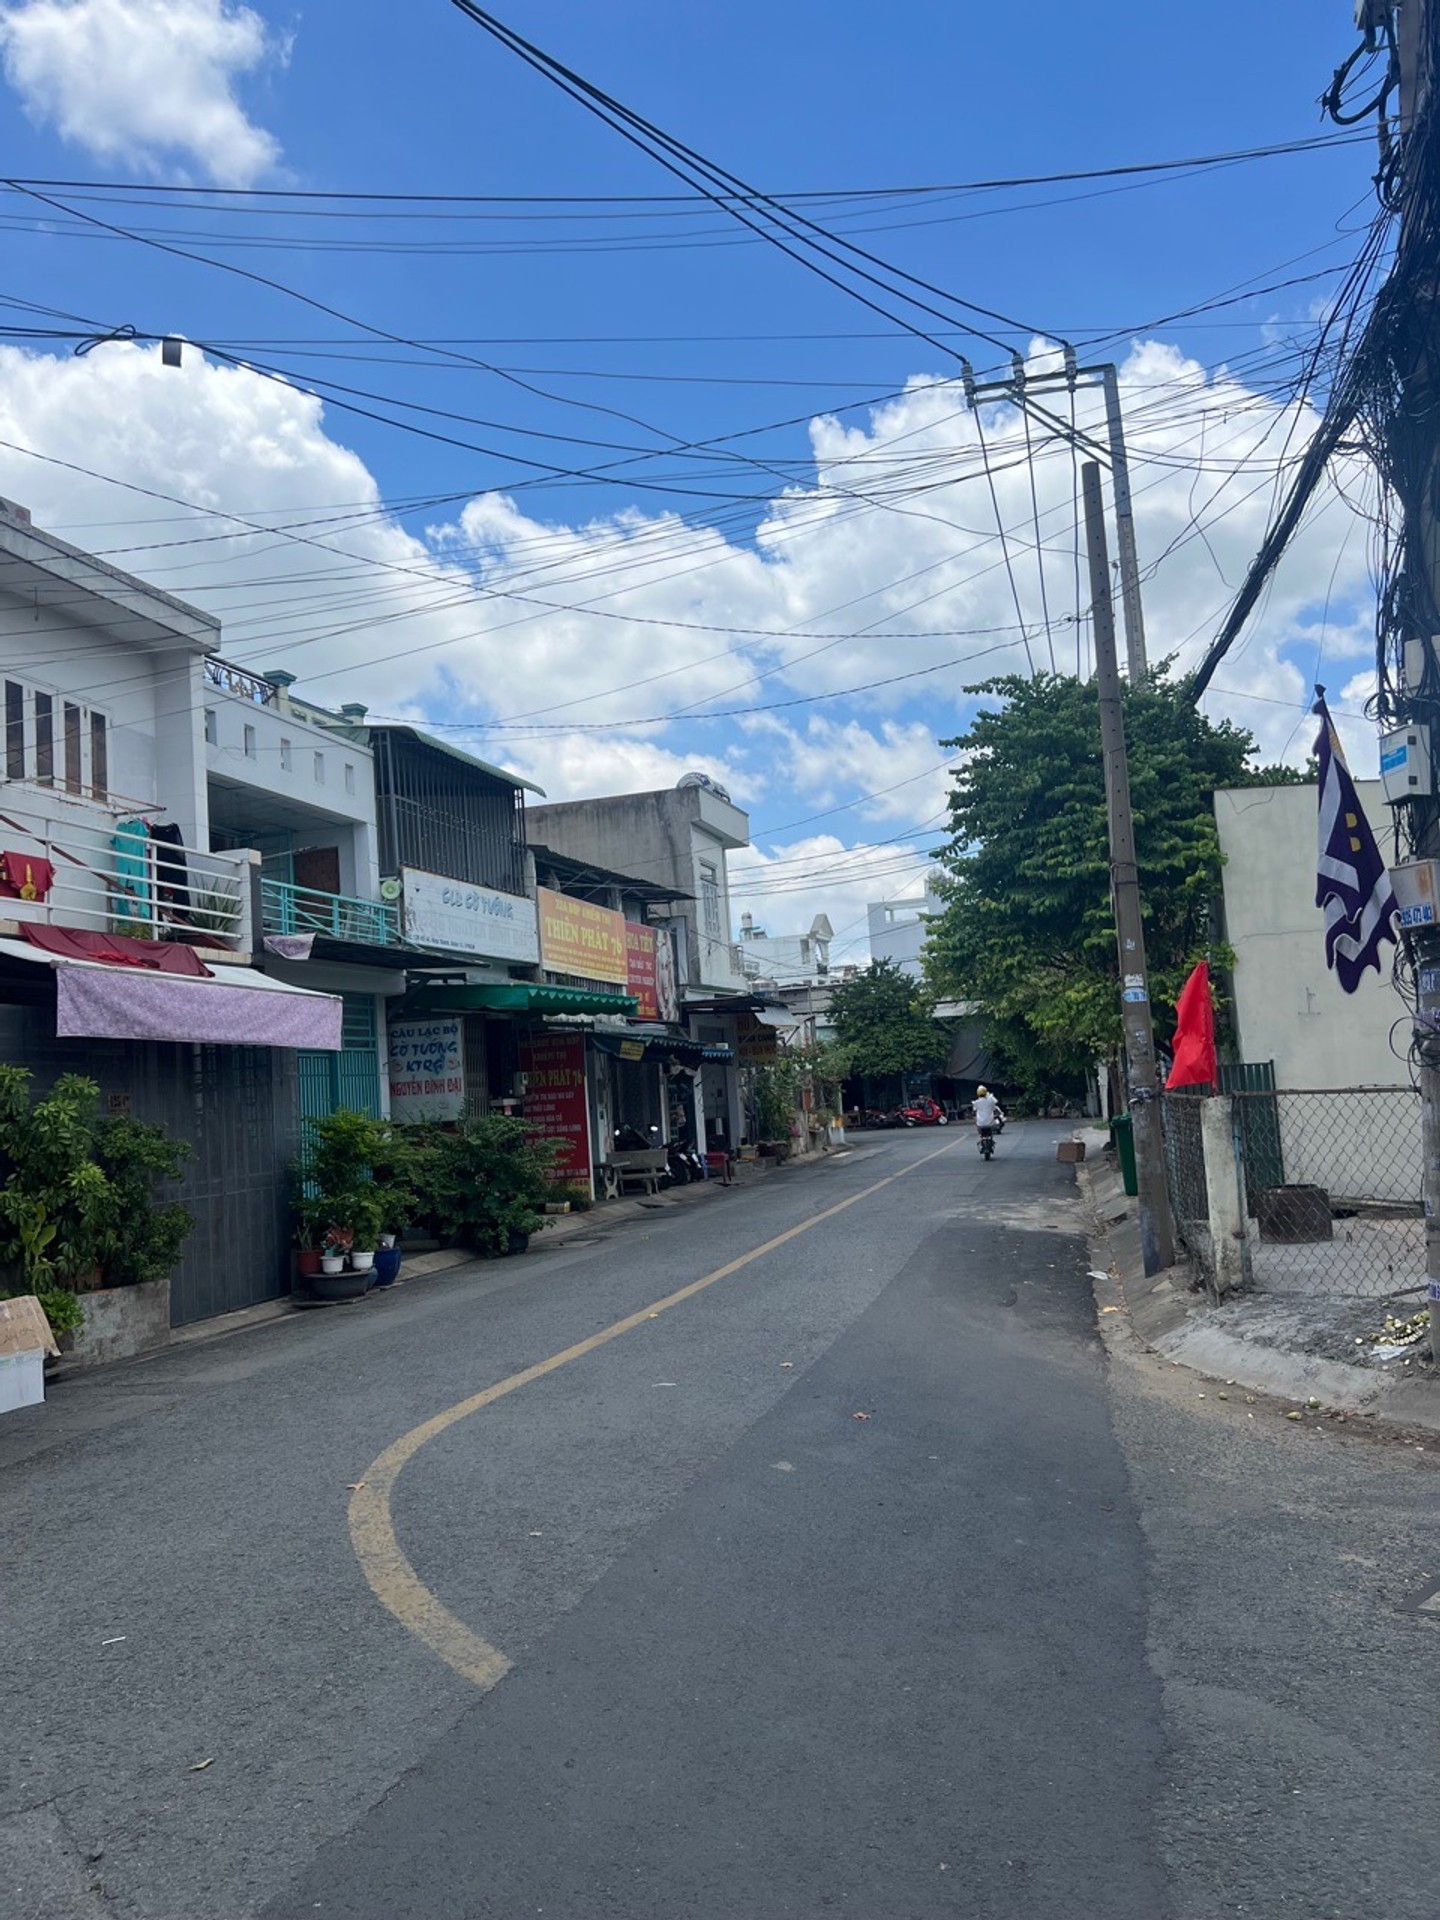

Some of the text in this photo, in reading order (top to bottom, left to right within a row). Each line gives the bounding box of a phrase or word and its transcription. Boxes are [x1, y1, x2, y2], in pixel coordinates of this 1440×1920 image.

[418, 1026, 441, 1039] LẠC
[442, 1022, 459, 1036] BỘ
[390, 1038, 458, 1057] CỜ TƯỚNG
